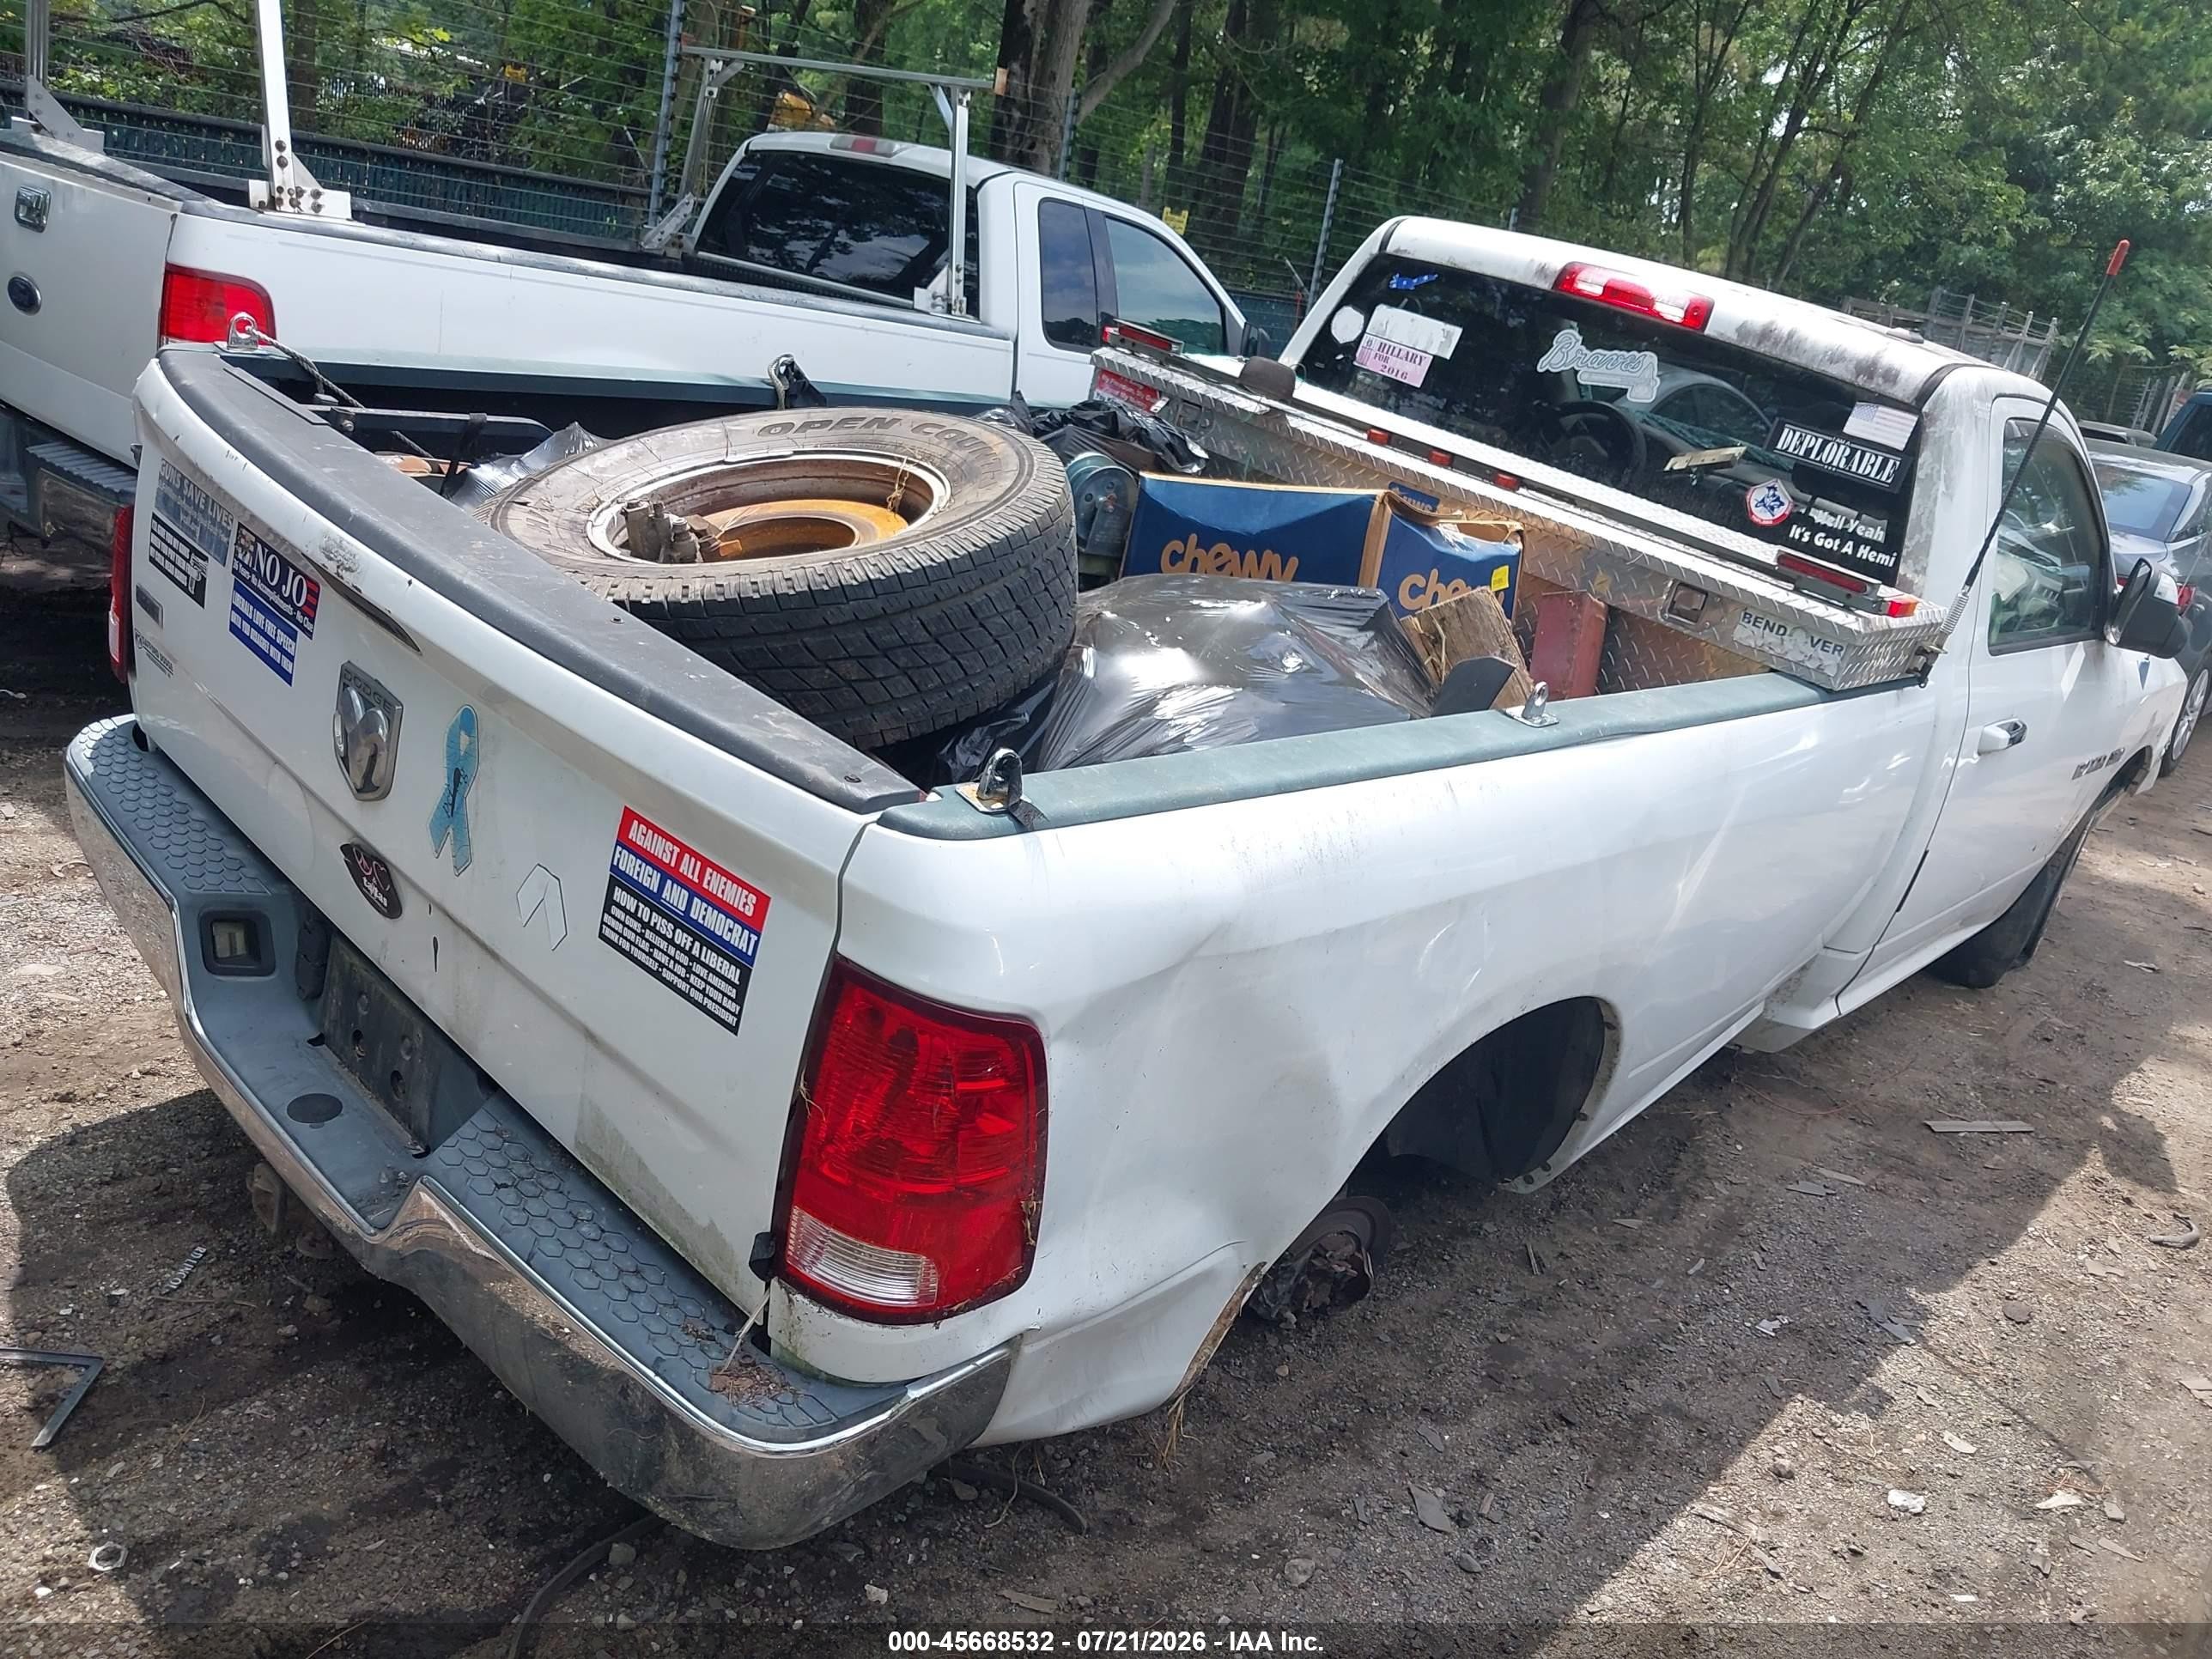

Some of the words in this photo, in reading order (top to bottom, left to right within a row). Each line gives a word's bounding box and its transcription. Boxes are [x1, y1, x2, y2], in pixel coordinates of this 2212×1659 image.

[1374, 352, 1390, 364] FOR
[1377, 342, 1426, 367] HILLARY
[1380, 364, 1408, 380] 2016
[1538, 330, 1647, 374] Braves
[757, 416, 902, 437] OPEN
[1776, 428, 1900, 483] DEPLORABLE
[183, 479, 206, 510] SAVE
[208, 498, 234, 531] LIVES
[1789, 525, 1811, 542] It's
[1814, 532, 1840, 550] Got
[1841, 540, 1854, 555] A
[1856, 544, 1898, 567] Hemi
[1847, 517, 1885, 541] Yeah
[253, 542, 281, 586] NO
[1399, 568, 1504, 611] che
[1741, 612, 1788, 636] BEND
[344, 668, 392, 714] DODGE
[629, 820, 680, 867] AGAINST
[679, 853, 702, 883] ALL
[702, 869, 757, 917] ENEMIES
[613, 845, 660, 893] FOREIGN
[661, 879, 689, 913] AND
[690, 896, 757, 957] DEMOCRAT
[611, 905, 625, 921] OWN
[624, 914, 643, 932] GUNS
[645, 926, 667, 950] BELIEVE
[666, 941, 675, 955] IN
[674, 948, 690, 966] GOD
[692, 962, 708, 978] LOVE
[707, 969, 737, 1000] AMERICA
[613, 886, 638, 909] HOW
[638, 902, 651, 922] TO
[650, 910, 674, 939] PISS
[674, 927, 692, 951] OFF
[692, 940, 702, 958] A
[701, 946, 740, 985] LIBERAL
[601, 924, 619, 942] THINK
[619, 936, 631, 951] FOR
[630, 944, 659, 972] YOURSELF
[662, 967, 690, 994] SUPPORT
[690, 987, 703, 1004] OUR
[702, 996, 738, 1028] PRESIDENT
[604, 913, 623, 932] HONOR
[623, 924, 636, 939] OUR
[635, 933, 650, 953] FLAG
[653, 945, 671, 965] HAVE
[673, 963, 687, 979] JOB
[690, 975, 705, 992] KEEP
[705, 985, 723, 1004] YOUR
[723, 995, 741, 1016] BABY
